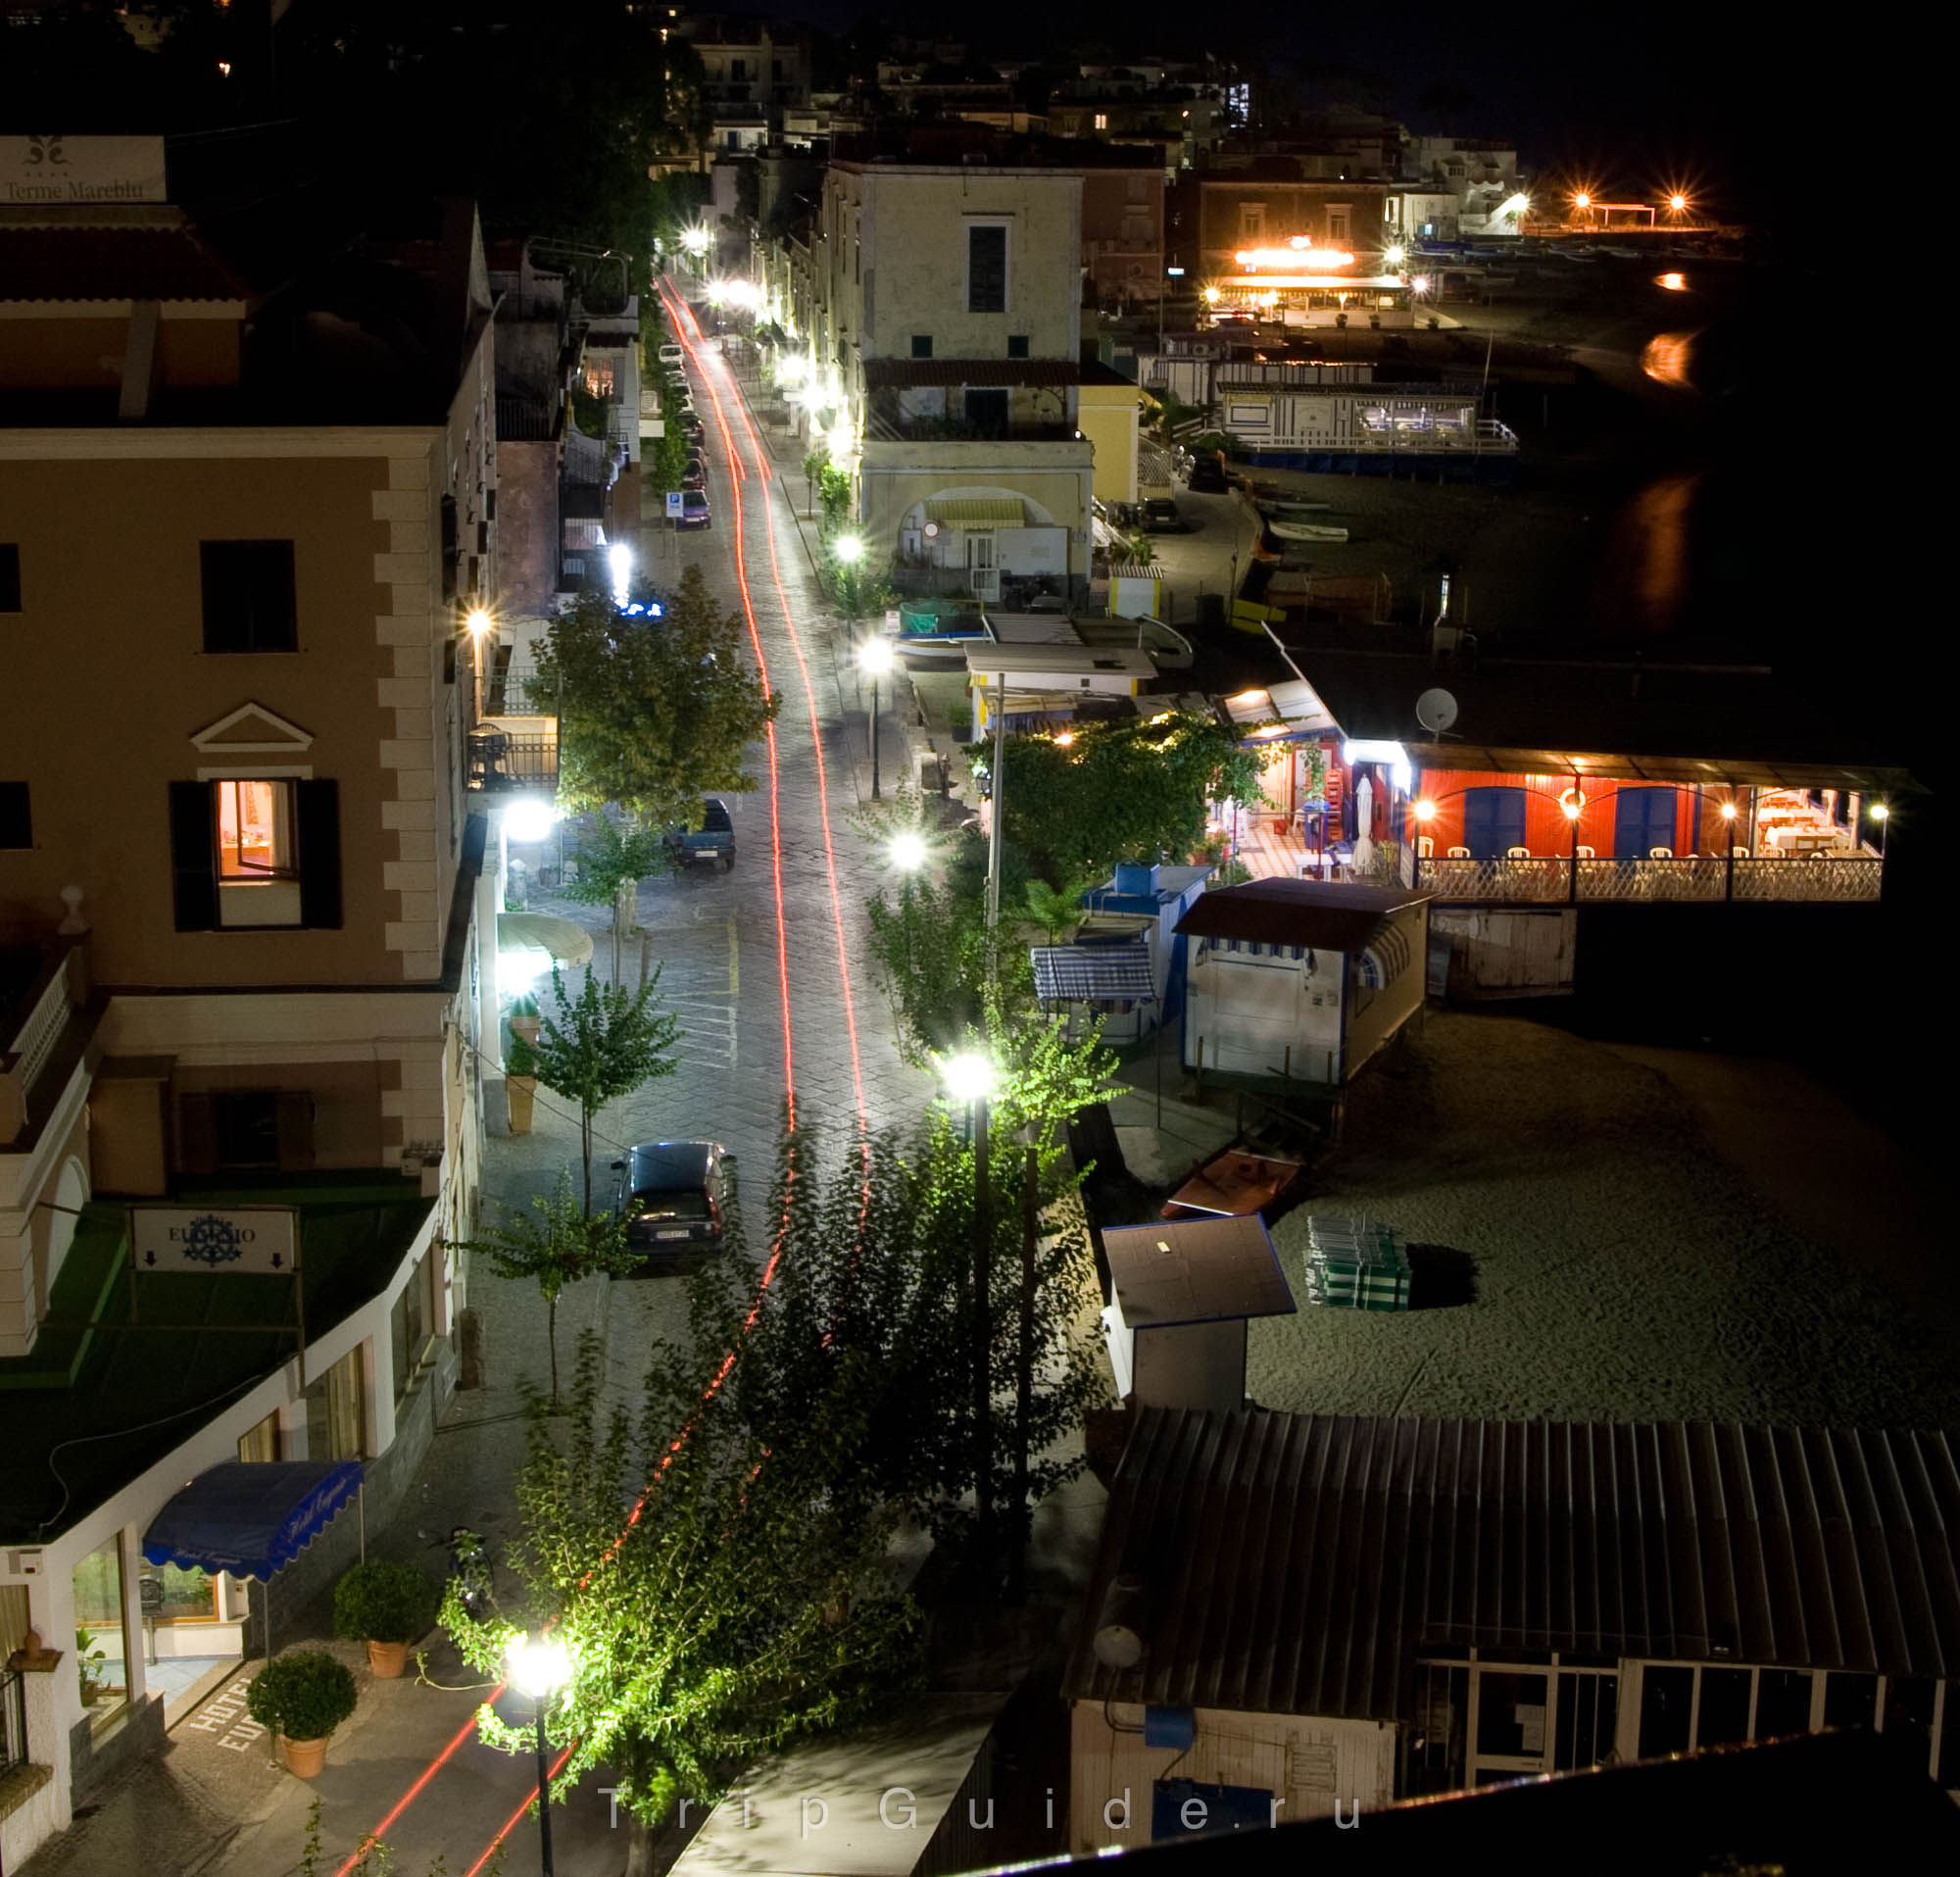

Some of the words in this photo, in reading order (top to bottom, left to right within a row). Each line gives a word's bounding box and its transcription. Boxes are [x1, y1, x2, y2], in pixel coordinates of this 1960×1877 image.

[7, 180, 63, 200] Terme
[69, 179, 144, 200] Mareblu
[169, 1227, 256, 1243] EUIO
